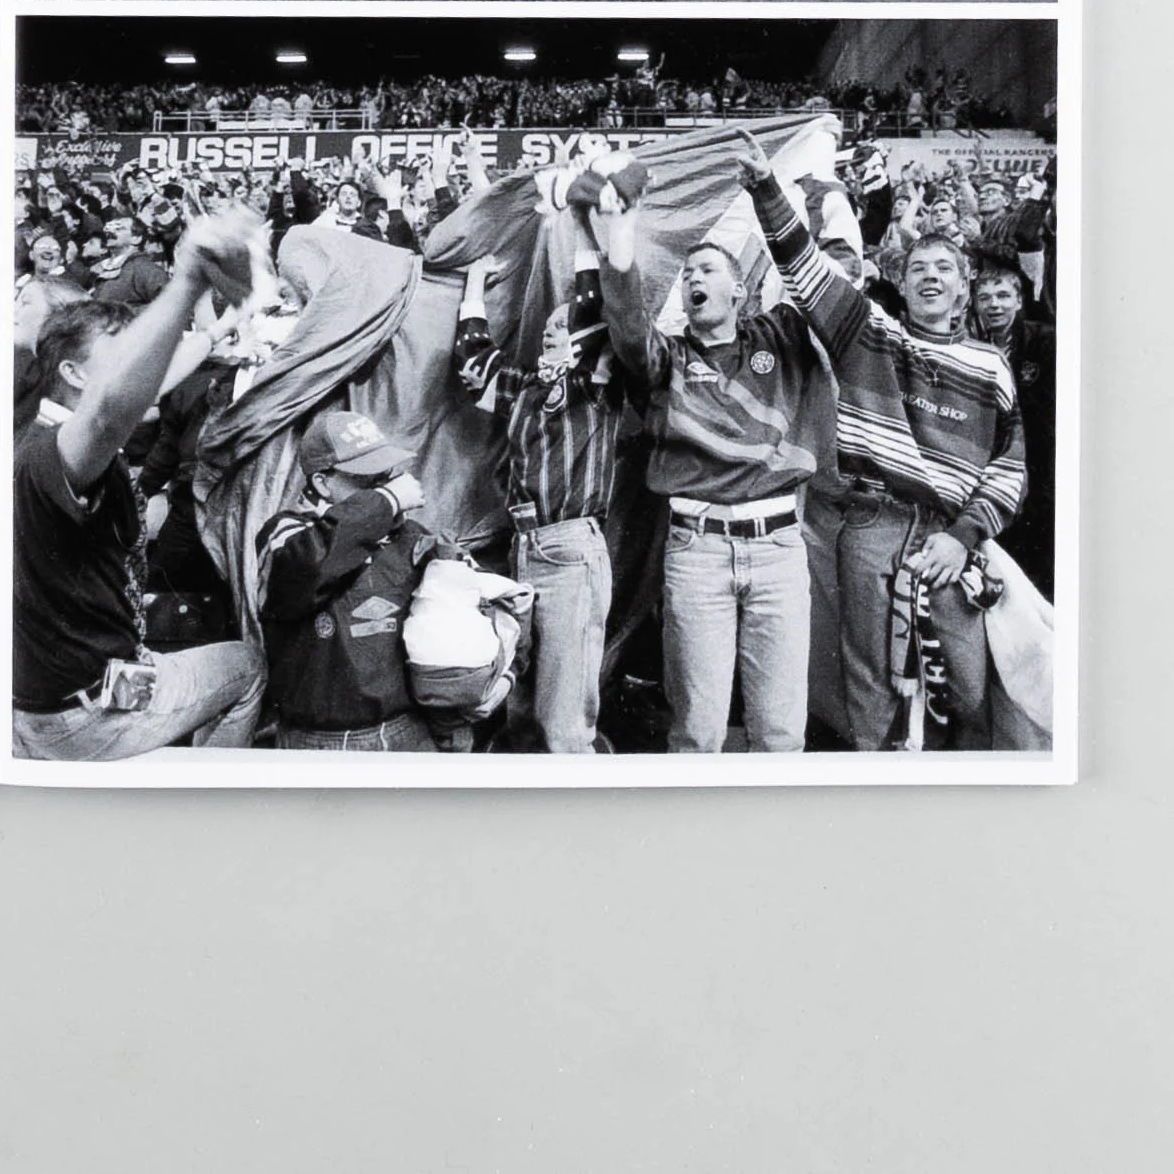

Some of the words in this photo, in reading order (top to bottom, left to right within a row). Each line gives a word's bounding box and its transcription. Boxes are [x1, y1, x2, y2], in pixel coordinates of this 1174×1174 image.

[139, 135, 328, 168] RUSSELL
[954, 148, 1002, 156] OFFIAL
[903, 392, 938, 414] EATER
[938, 406, 968, 421] SHOP
